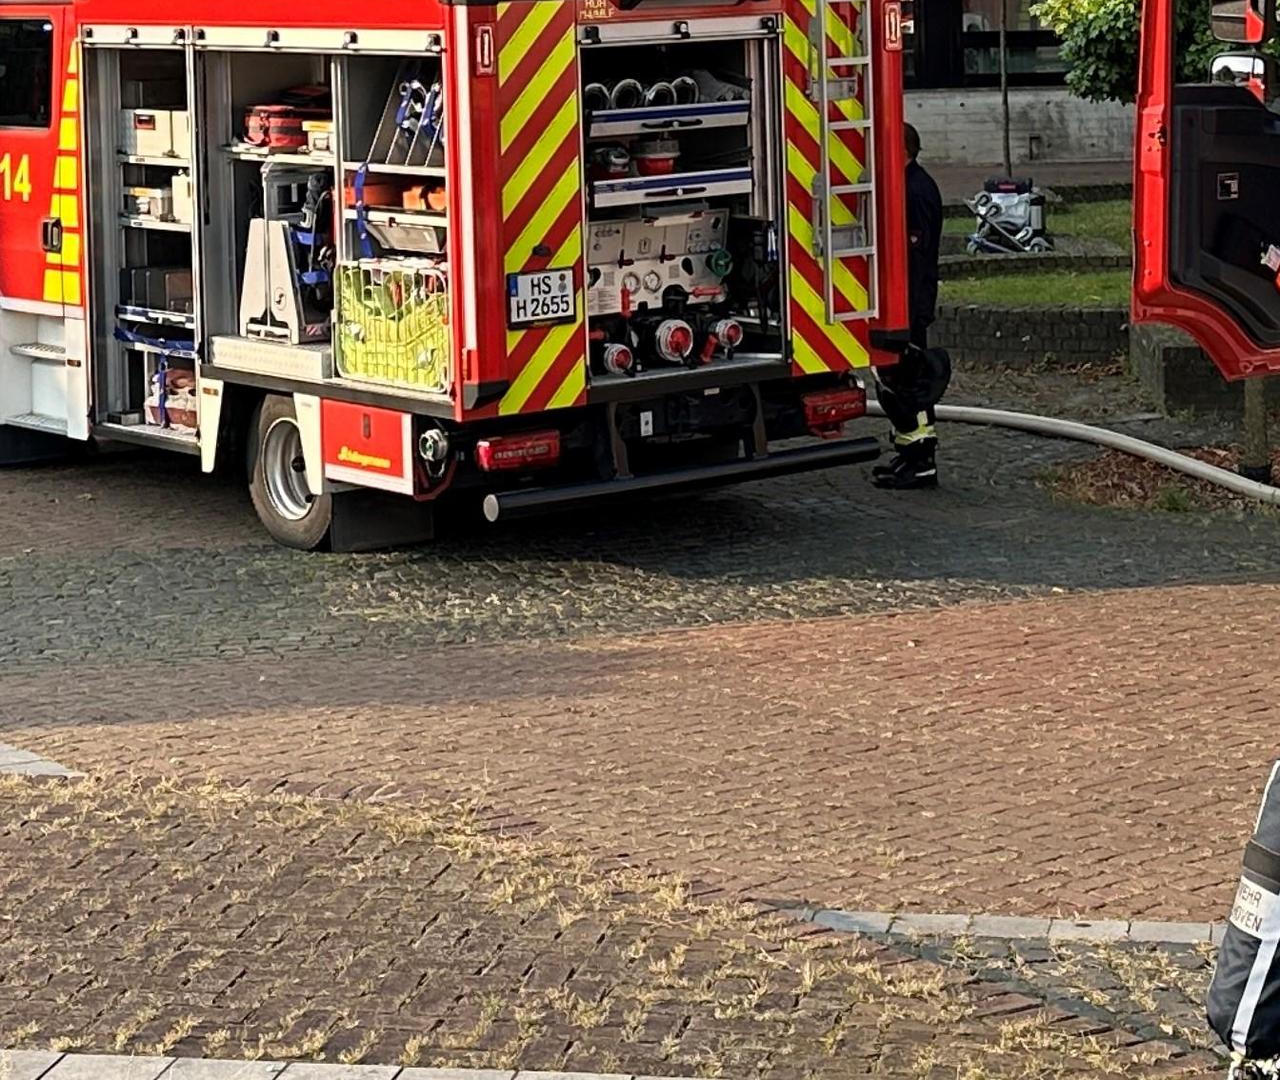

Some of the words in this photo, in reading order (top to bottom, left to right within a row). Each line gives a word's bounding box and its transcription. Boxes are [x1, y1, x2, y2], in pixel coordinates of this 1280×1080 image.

[0, 152, 32, 202] 14
[530, 276, 552, 296] HS
[516, 299, 527, 319] H
[530, 294, 570, 317] 2655
